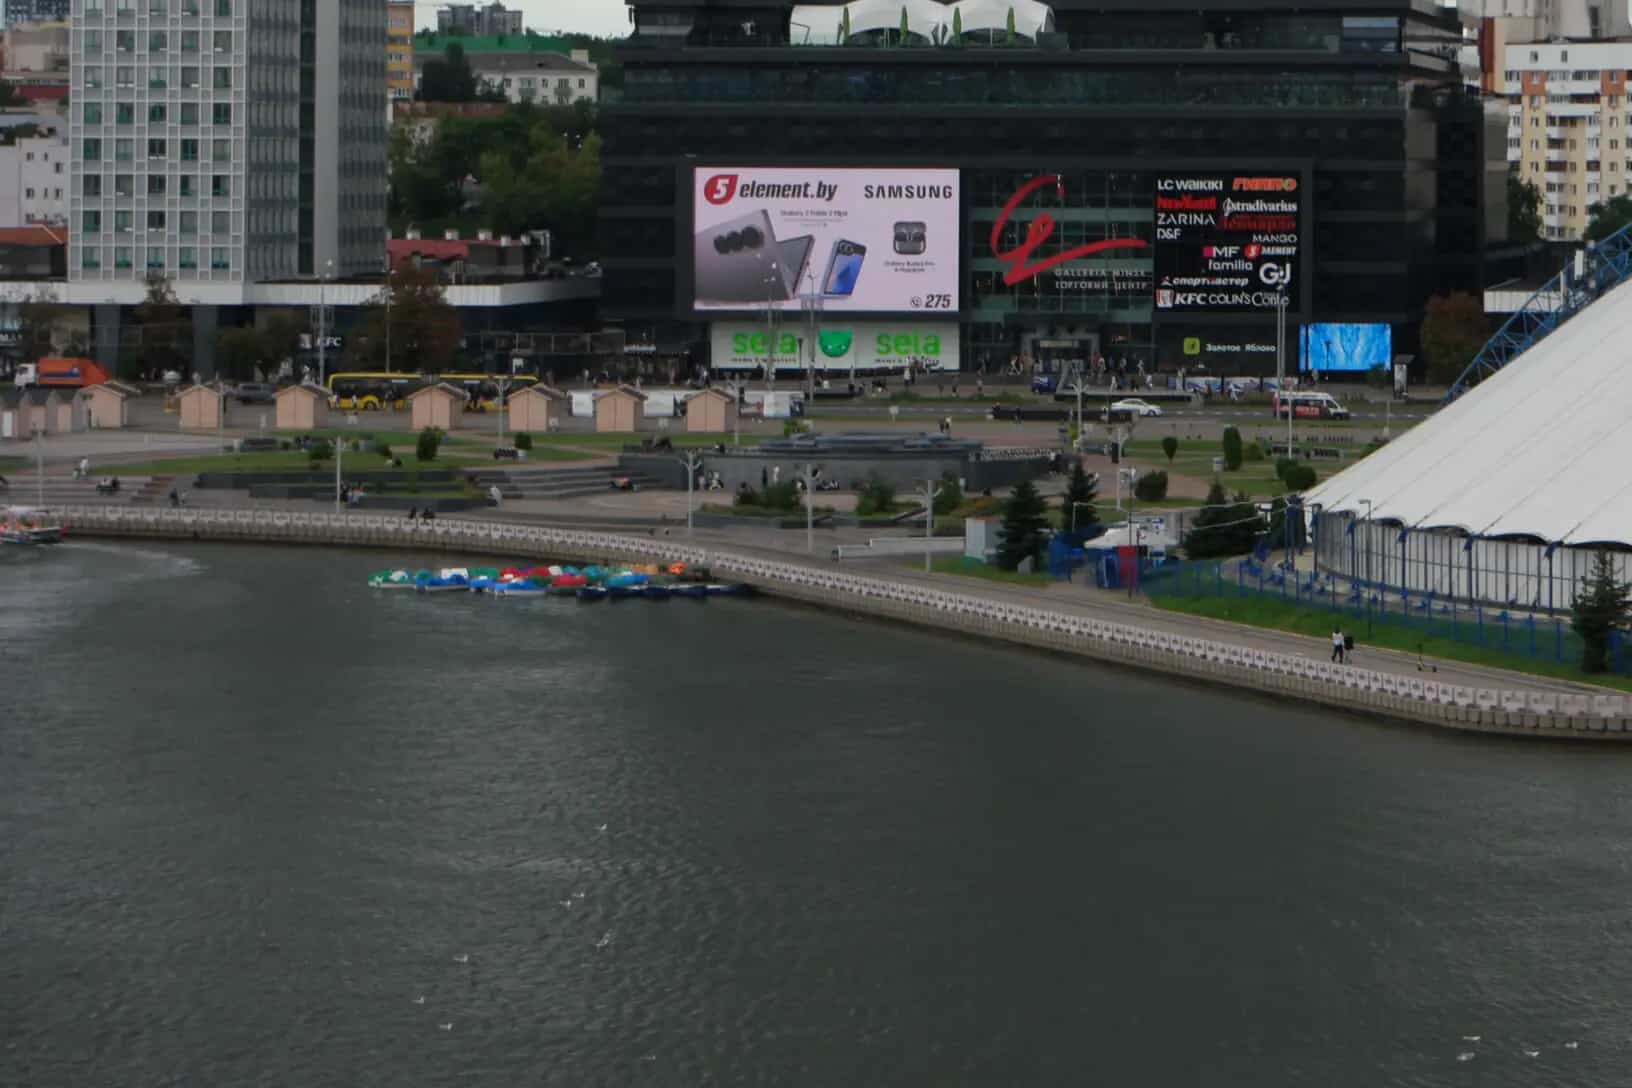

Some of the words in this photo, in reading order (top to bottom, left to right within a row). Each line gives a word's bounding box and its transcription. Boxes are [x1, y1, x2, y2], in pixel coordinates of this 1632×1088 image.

[712, 178, 729, 200] 5
[738, 180, 838, 202] element.by
[1157, 178, 1174, 191] LC
[863, 184, 953, 200] SAMSUNG
[1157, 213, 1216, 226] ZARINA
[1156, 227, 1182, 240] D&F
[1252, 233, 1298, 244] MANGO
[1208, 259, 1254, 272] familia
[924, 294, 952, 309] 275
[1174, 293, 1208, 306] KFC
[875, 326, 941, 356] sela
[1205, 343, 1241, 352] Золотое
[1244, 343, 1277, 352] Яблоко
